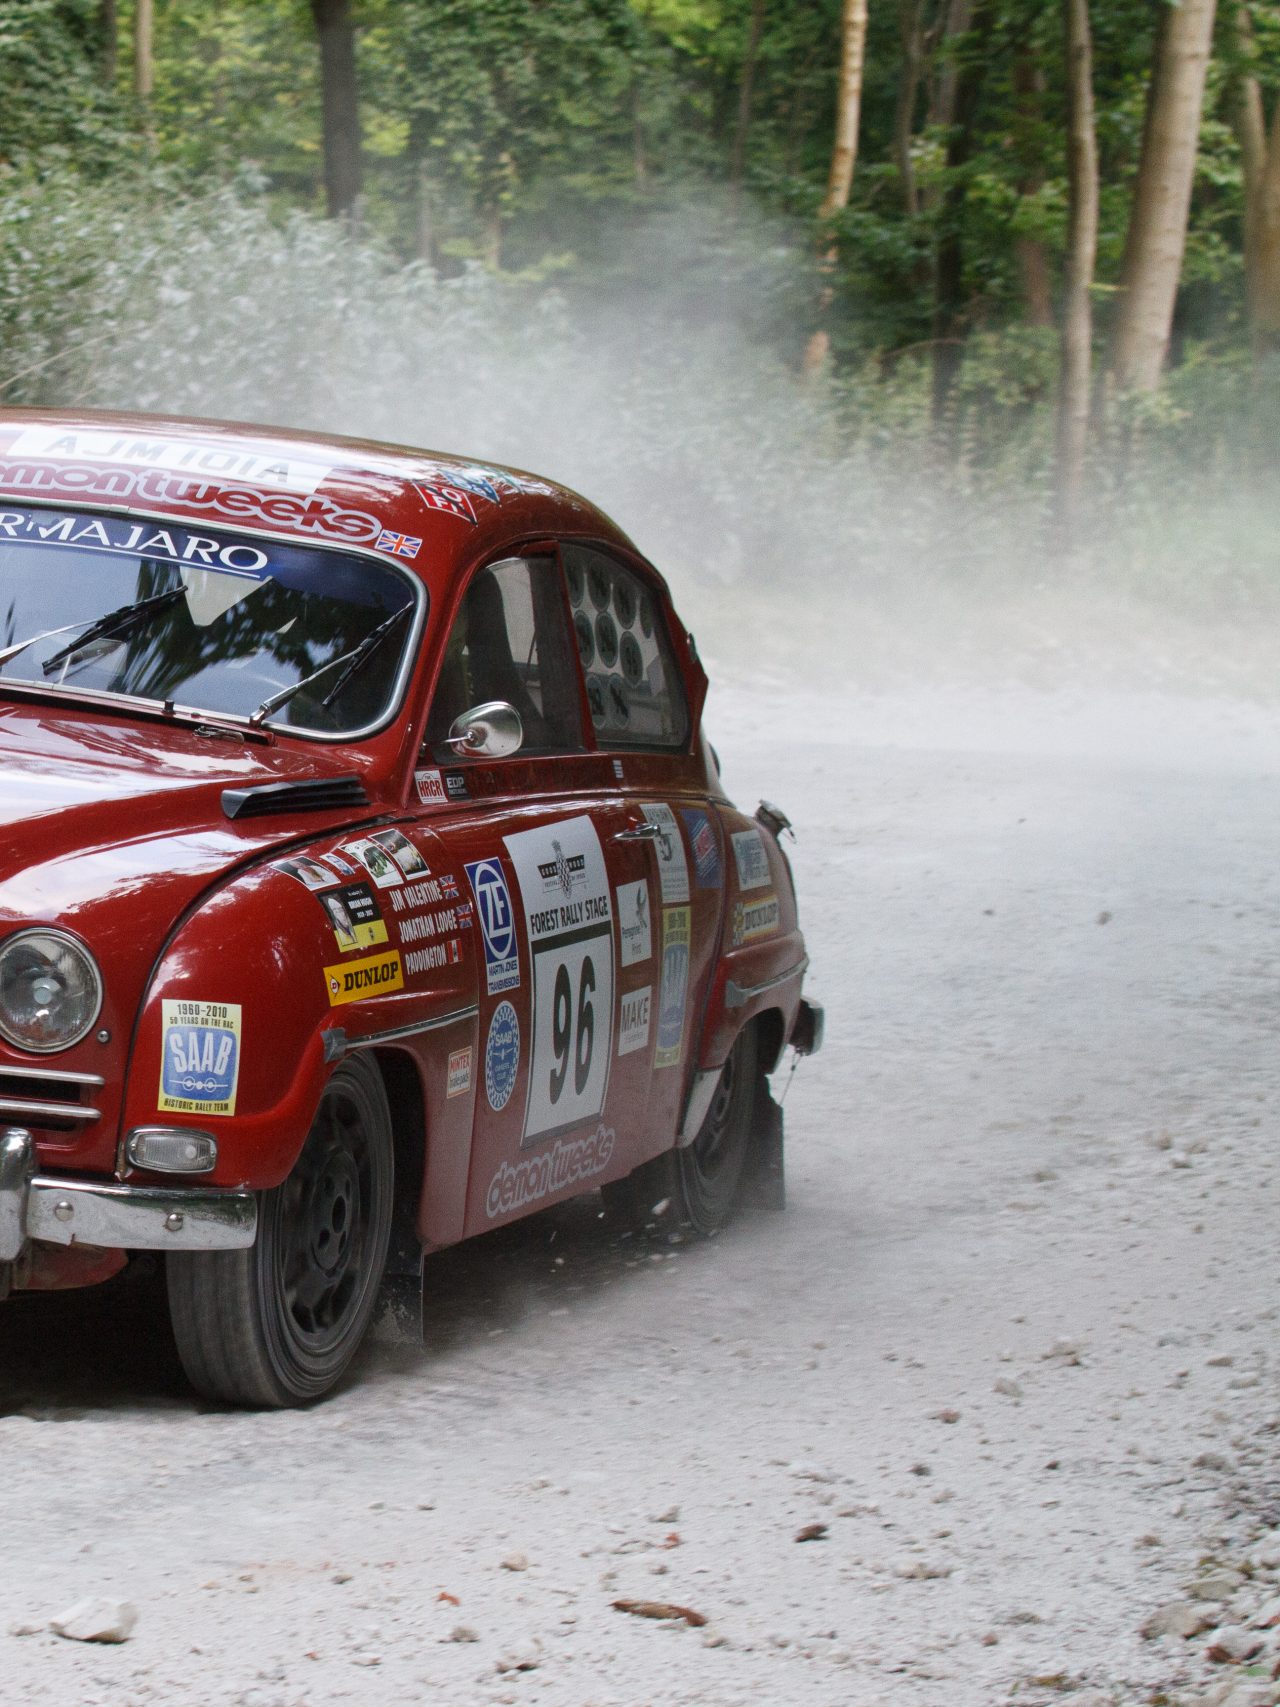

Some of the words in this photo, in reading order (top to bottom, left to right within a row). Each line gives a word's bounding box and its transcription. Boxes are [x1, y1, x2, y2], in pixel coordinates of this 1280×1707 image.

[45, 434, 169, 463] AJM
[418, 780, 443, 797] HRCR
[446, 777, 464, 789] EDP
[389, 888, 407, 912] JIM
[403, 879, 443, 908] VALENTINE
[478, 881, 511, 939] ZF
[399, 912, 435, 943] JONATHAN
[434, 909, 458, 934] LODGE
[530, 908, 559, 935] FOREST
[560, 902, 583, 927] RALLY
[585, 896, 609, 921] STAGE
[405, 944, 447, 975] PADDINGTON
[489, 963, 505, 977] MARTIN
[505, 959, 518, 973] JONES
[343, 961, 399, 992] DUNLOP
[177, 1003, 228, 1019] 1960-2010
[180, 1017, 199, 1025] YEARS
[211, 1019, 221, 1027] THE
[622, 997, 648, 1033] MAKE
[495, 1031, 513, 1047] SAAB
[550, 955, 596, 1105] 96
[169, 1031, 233, 1076] SAAB
[164, 1098, 193, 1110] HISTORIC
[194, 1102, 213, 1112] RALLY
[214, 1103, 229, 1112] TEAM
